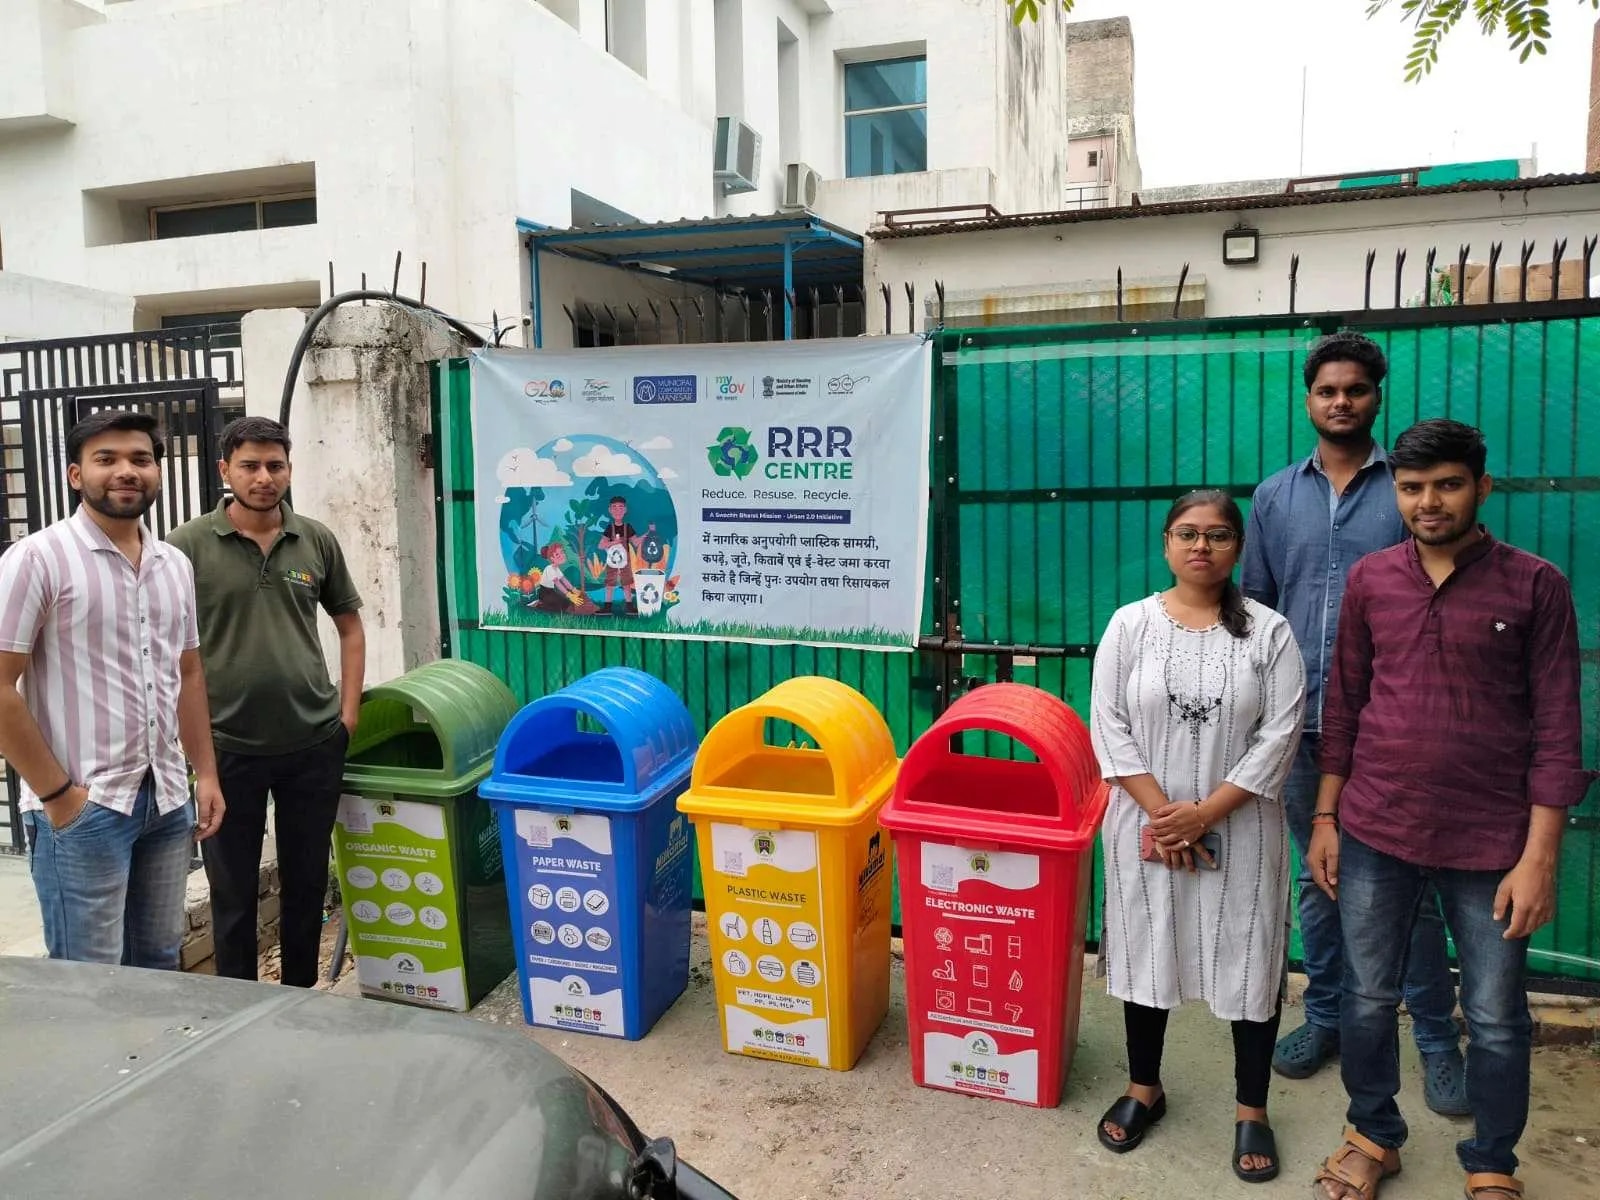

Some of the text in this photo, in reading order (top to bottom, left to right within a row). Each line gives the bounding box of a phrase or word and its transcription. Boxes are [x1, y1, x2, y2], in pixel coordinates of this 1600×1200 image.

[716, 375, 733, 385] my
[720, 384, 745, 394] GOV
[768, 426, 852, 458] RRR
[764, 462, 853, 480] CENTRE
[702, 488, 851, 503] Reduce. Resuse. Recycle.
[702, 532, 879, 550] में नागरिक अनुपयोगी प्लास्टिक सामग्री,
[731, 552, 750, 568] जूते,
[754, 552, 785, 566] किताबें
[838, 557, 860, 569] जमा
[863, 558, 890, 570] करवा
[702, 570, 726, 583] सकते
[785, 572, 817, 587] उपयोग
[820, 577, 839, 587] तथा
[842, 574, 890, 589] रिसायकल
[702, 589, 725, 604] किया
[345, 842, 437, 858] ORGANIC WASTE
[532, 856, 602, 872] PAPER WASTE
[727, 885, 807, 903] PLASTIC WASTE
[925, 897, 1035, 919] ELECTRONIC WASTE
